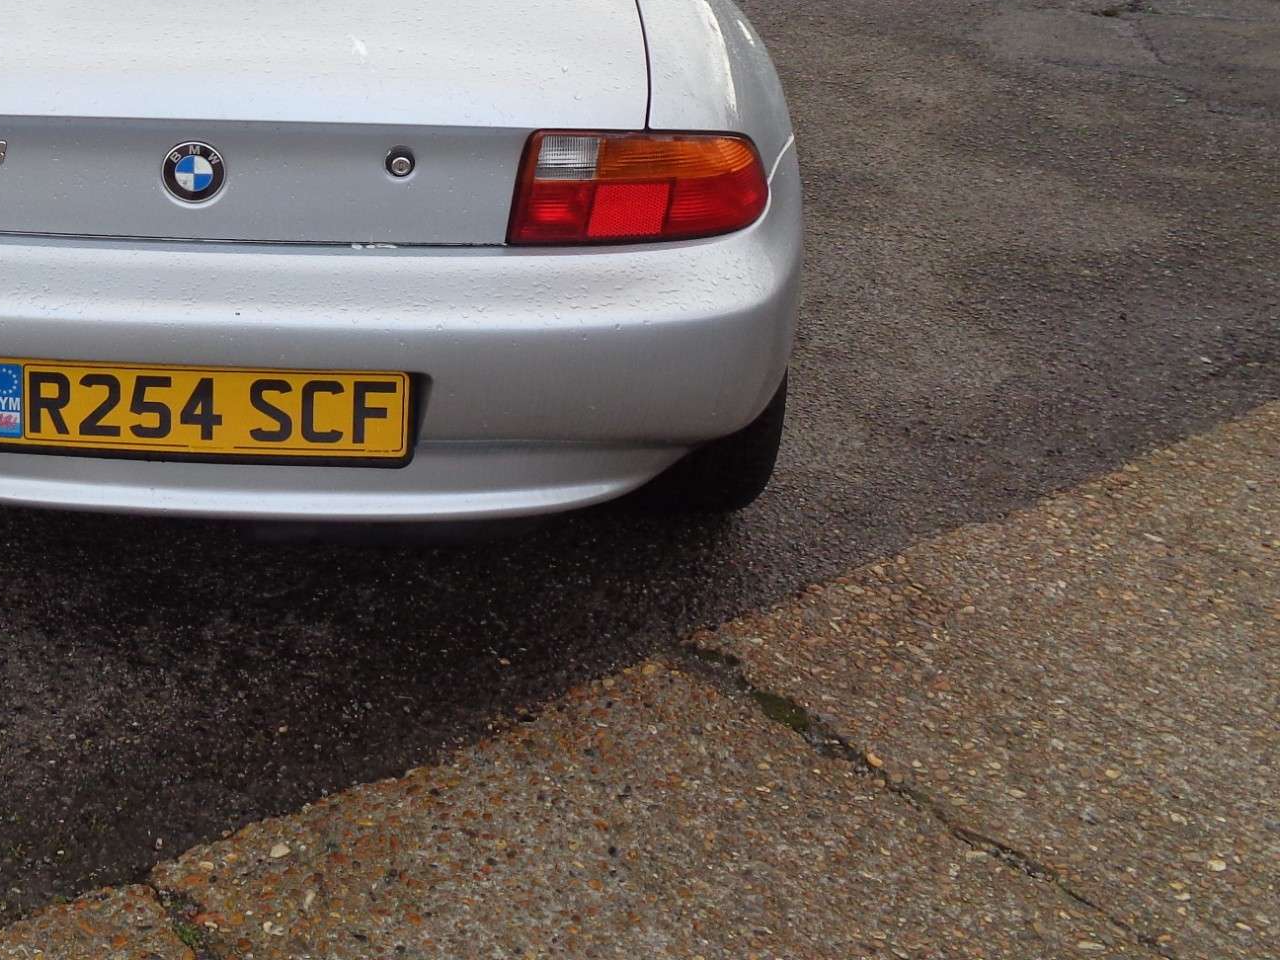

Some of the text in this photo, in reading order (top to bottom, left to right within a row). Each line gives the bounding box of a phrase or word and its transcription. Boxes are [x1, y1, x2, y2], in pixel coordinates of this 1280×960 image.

[169, 145, 221, 165] BMW
[29, 371, 398, 445] R254 SCF
